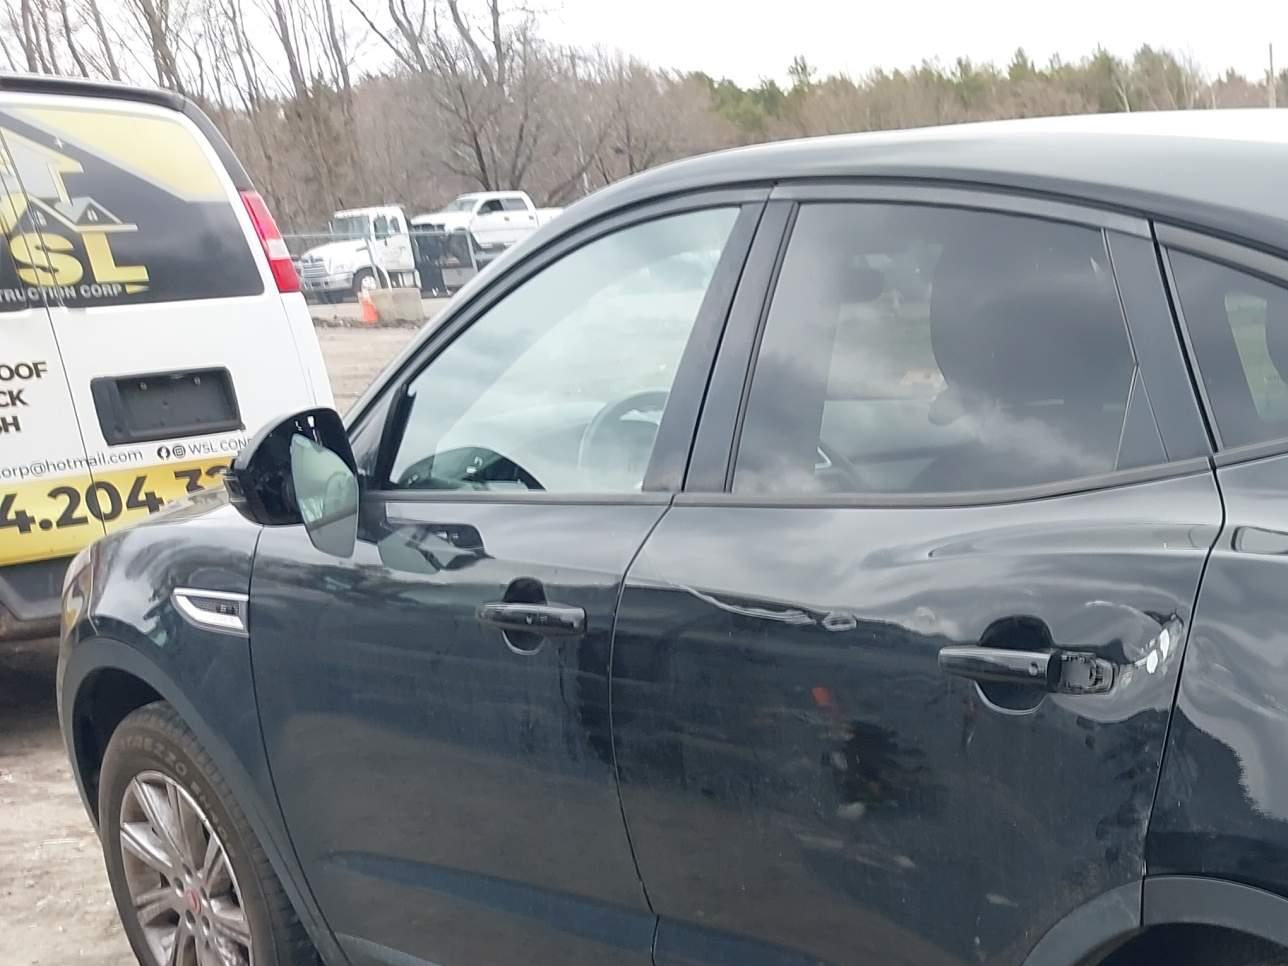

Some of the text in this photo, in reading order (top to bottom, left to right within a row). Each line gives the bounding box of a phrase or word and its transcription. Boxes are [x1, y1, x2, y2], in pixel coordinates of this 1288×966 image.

[79, 283, 123, 298] CORP
[0, 361, 48, 381] OOF
[0, 415, 21, 434] H
[0, 437, 252, 480] orp@hotmail.com WSL CON
